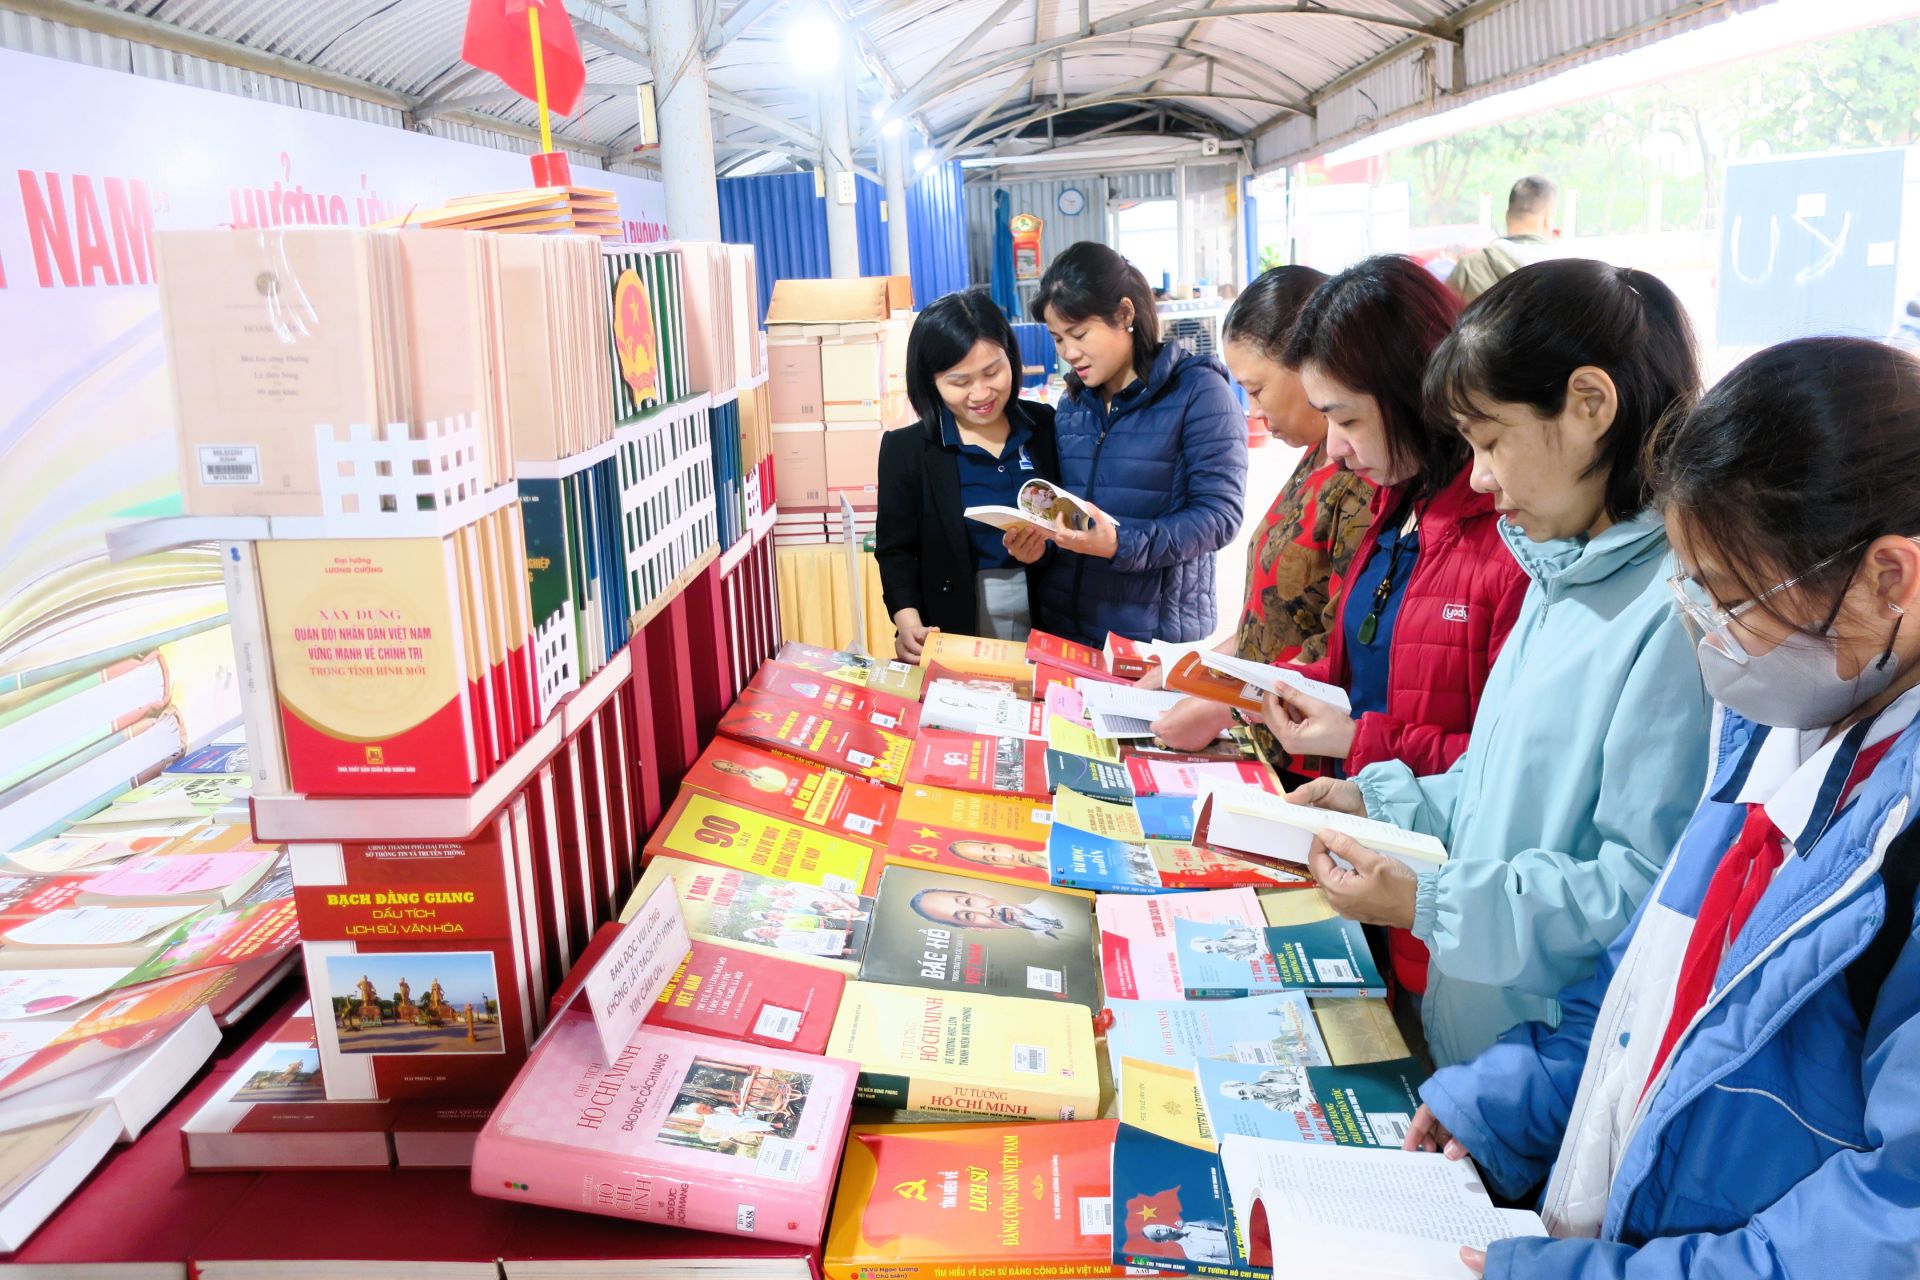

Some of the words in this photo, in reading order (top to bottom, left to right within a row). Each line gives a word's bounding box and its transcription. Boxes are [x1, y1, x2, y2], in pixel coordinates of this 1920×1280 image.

[410, 628, 432, 640] NAM
[310, 667, 346, 676] TRONG
[691, 812, 742, 851] 90
[327, 894, 371, 907] BẠCH
[424, 892, 474, 903] GIANG
[373, 907, 403, 918] DẤU
[405, 907, 435, 918] TÍCH
[606, 982, 629, 1018] KHÔNG
[986, 1101, 1028, 1114] MINH
[1003, 1135, 1019, 1154] NAM
